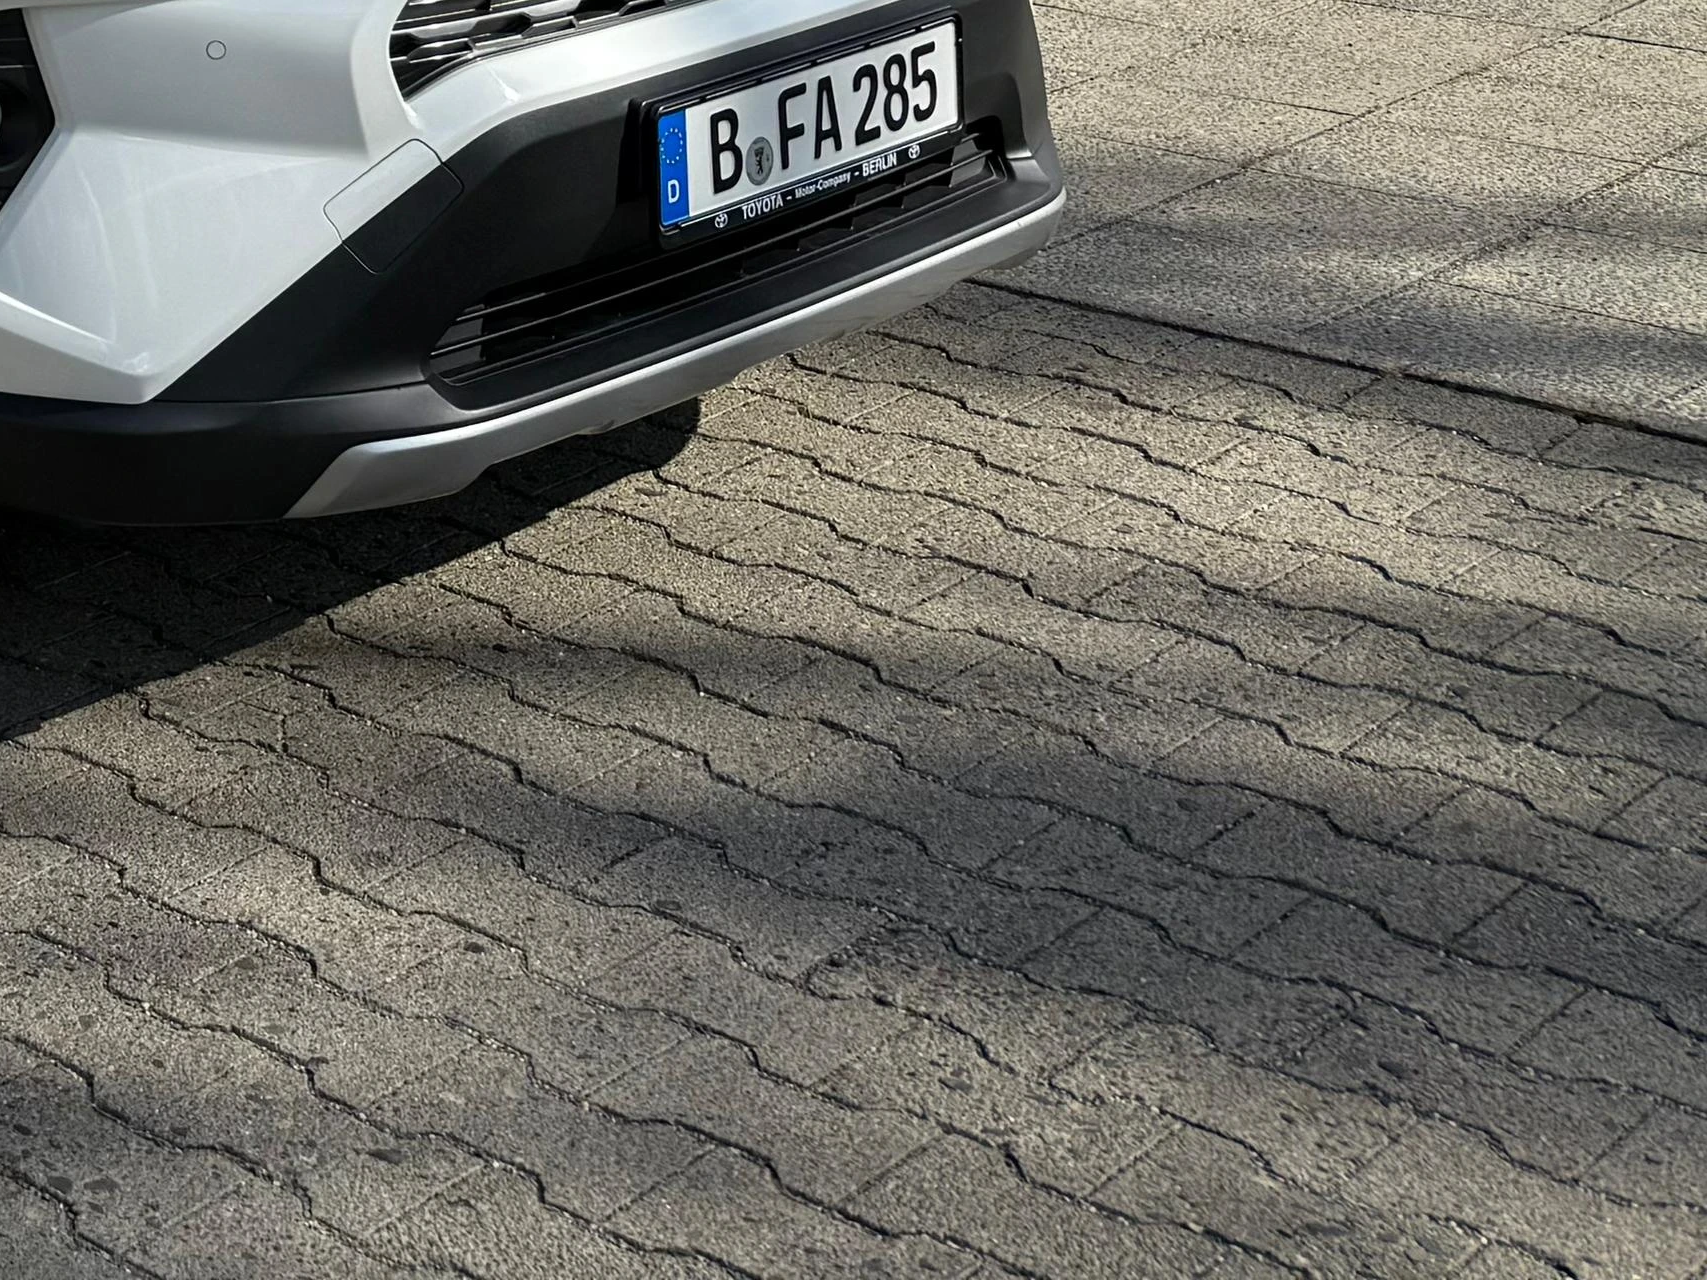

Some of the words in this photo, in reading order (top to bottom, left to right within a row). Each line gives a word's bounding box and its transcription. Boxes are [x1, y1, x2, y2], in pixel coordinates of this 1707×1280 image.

[709, 107, 743, 195] B
[777, 75, 843, 170] FA
[852, 41, 938, 146] 285
[667, 178, 680, 204] D
[741, 194, 784, 220] TOYOTA
[794, 171, 852, 199] Motor-Company
[861, 152, 898, 177] BERLIN
